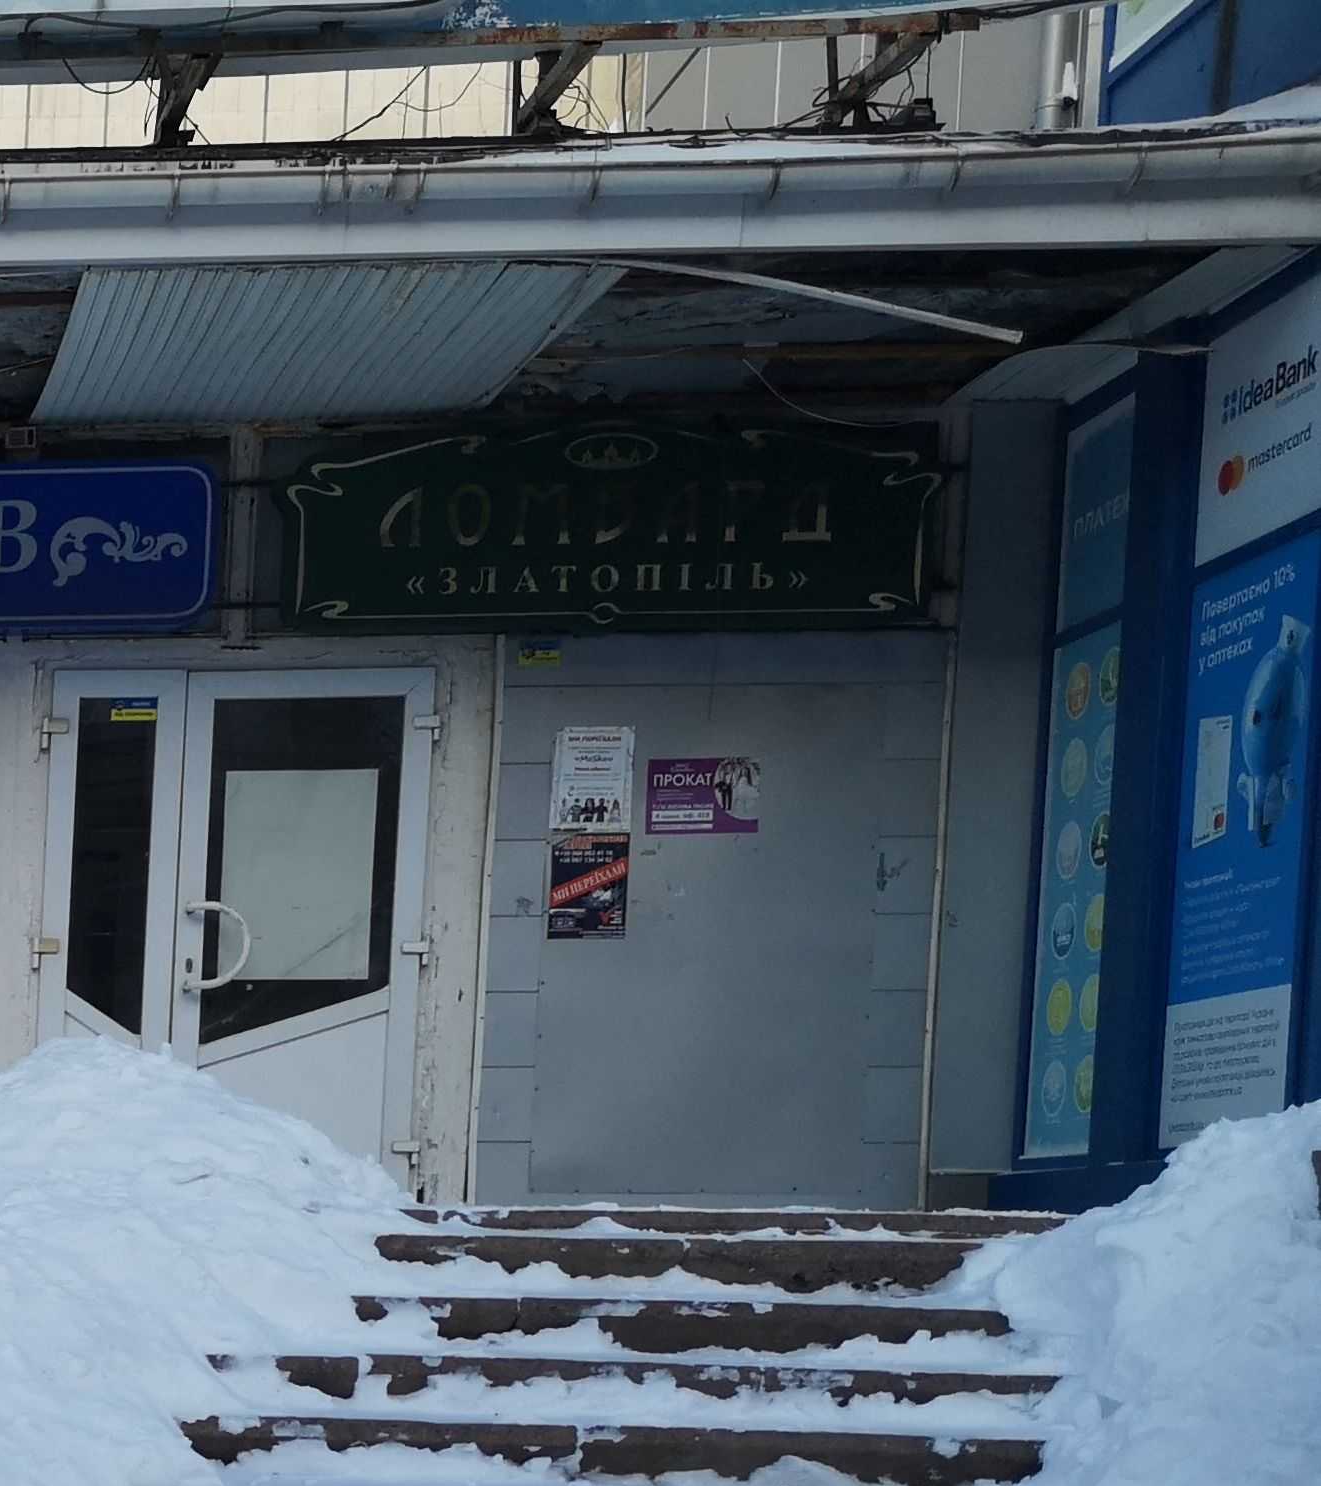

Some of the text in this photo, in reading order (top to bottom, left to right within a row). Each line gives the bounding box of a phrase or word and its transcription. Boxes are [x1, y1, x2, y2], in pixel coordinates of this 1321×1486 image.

[1247, 422, 1312, 472] mastercard
[406, 562, 808, 595] «ЗЛАТОПІЛЬ»
[1201, 564, 1296, 622] Повертаємо 10%
[1218, 606, 1266, 638] покупок
[1207, 636, 1254, 668] аптеках
[653, 773, 713, 787] ПРОКАТ
